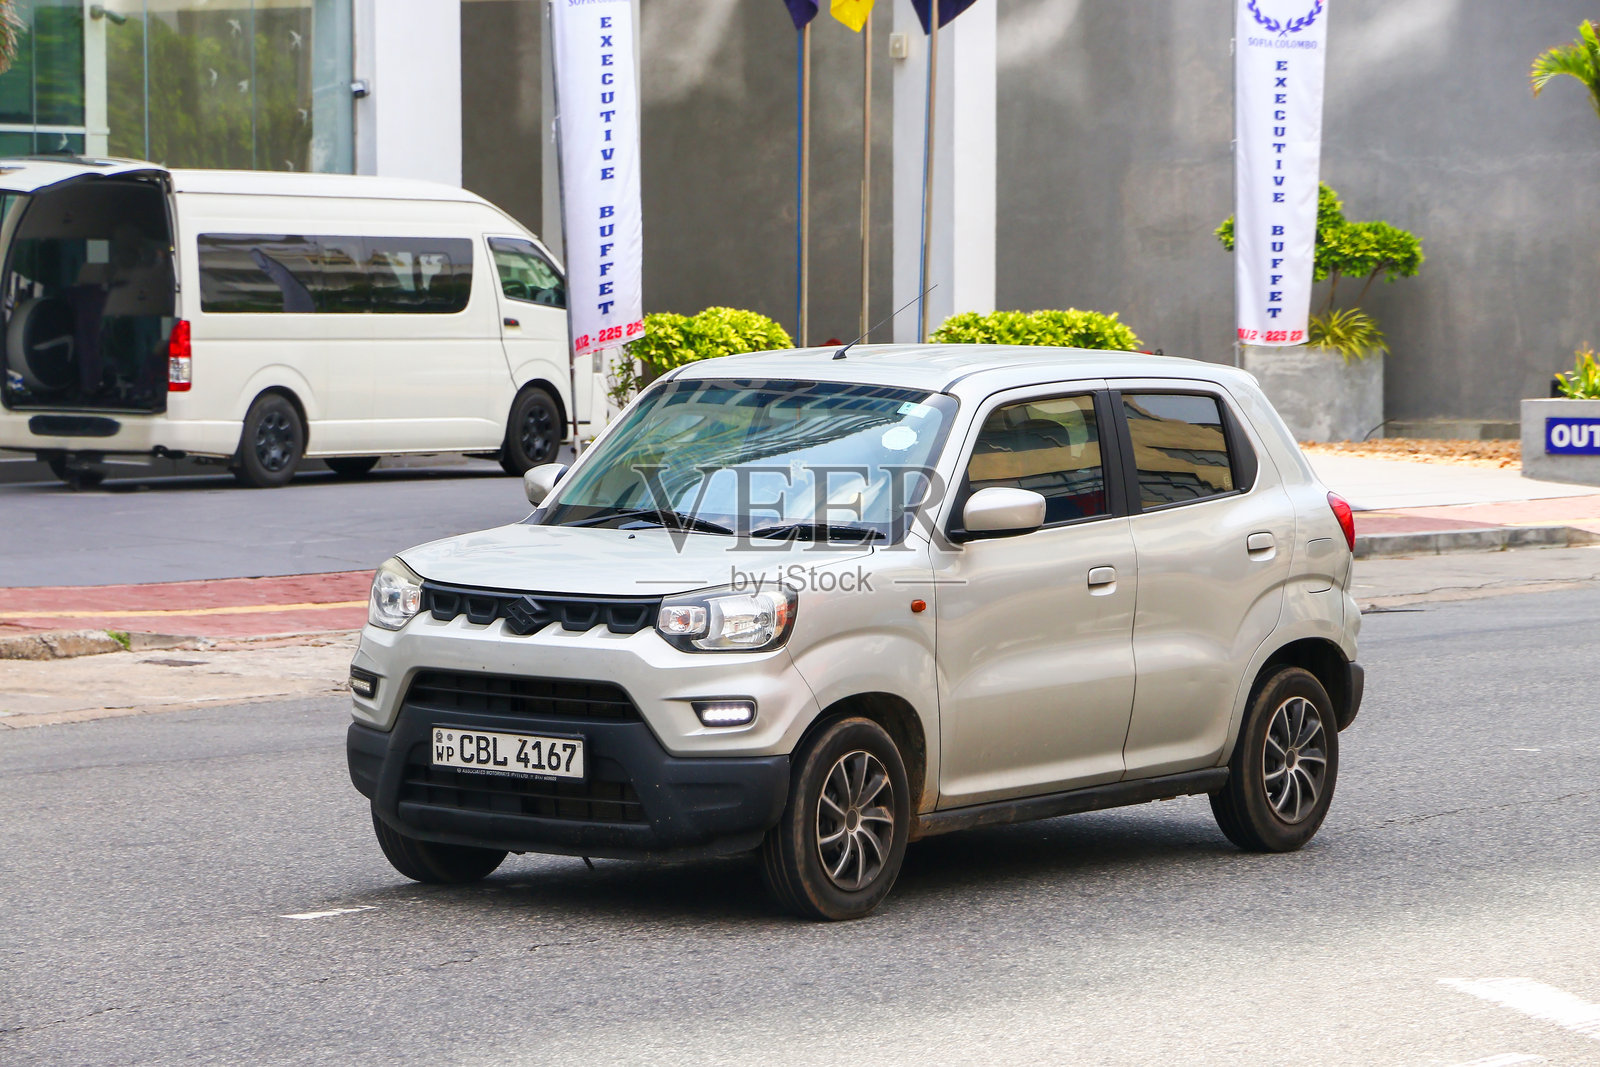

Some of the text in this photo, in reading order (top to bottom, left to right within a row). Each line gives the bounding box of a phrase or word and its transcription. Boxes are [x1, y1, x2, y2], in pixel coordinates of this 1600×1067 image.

[1248, 37, 1318, 50] SOFIA COLOMBO
[600, 16, 615, 180] EXECUTIVE
[1267, 60, 1288, 318] EXECUTIVE BUFFET
[598, 205, 614, 315] BUFFET
[599, 325, 622, 343] 225
[1265, 330, 1287, 342] 225
[1551, 424, 1600, 448] OUT
[436, 745, 454, 761] WP
[460, 734, 577, 772] CBL 4167
